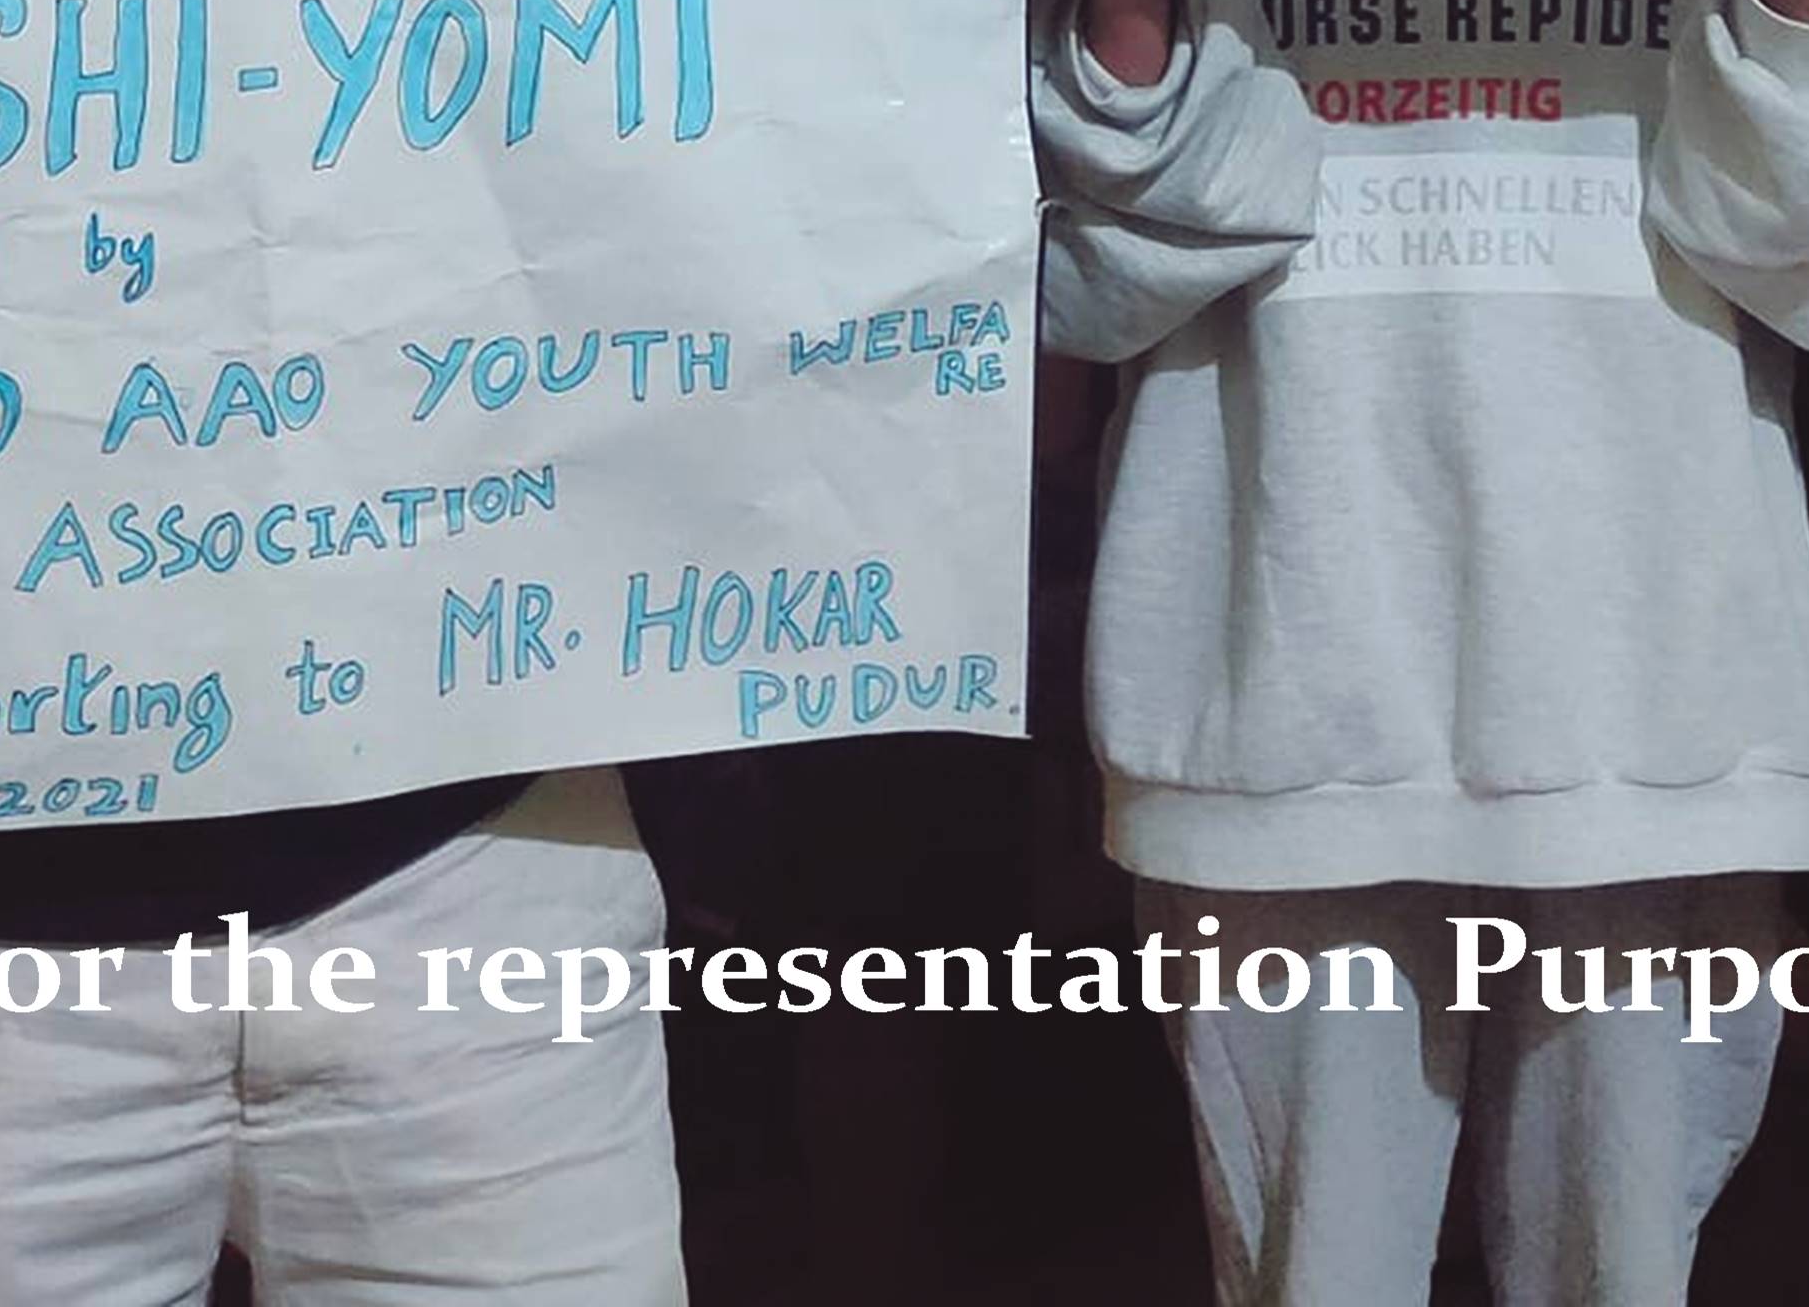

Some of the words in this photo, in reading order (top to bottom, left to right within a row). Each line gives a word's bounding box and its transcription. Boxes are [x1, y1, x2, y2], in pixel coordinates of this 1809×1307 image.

[1301, 78, 1563, 123] ORZEITIG
[81, 214, 156, 304] by
[1401, 229, 1555, 268] HABEN
[101, 352, 327, 454] AAO
[401, 323, 732, 421] YOUTH
[936, 350, 1006, 395] RE
[14, 462, 559, 593] ASSOCIATION
[285, 639, 366, 717] to
[436, 575, 583, 698] MR.
[622, 562, 902, 676] HOKAR
